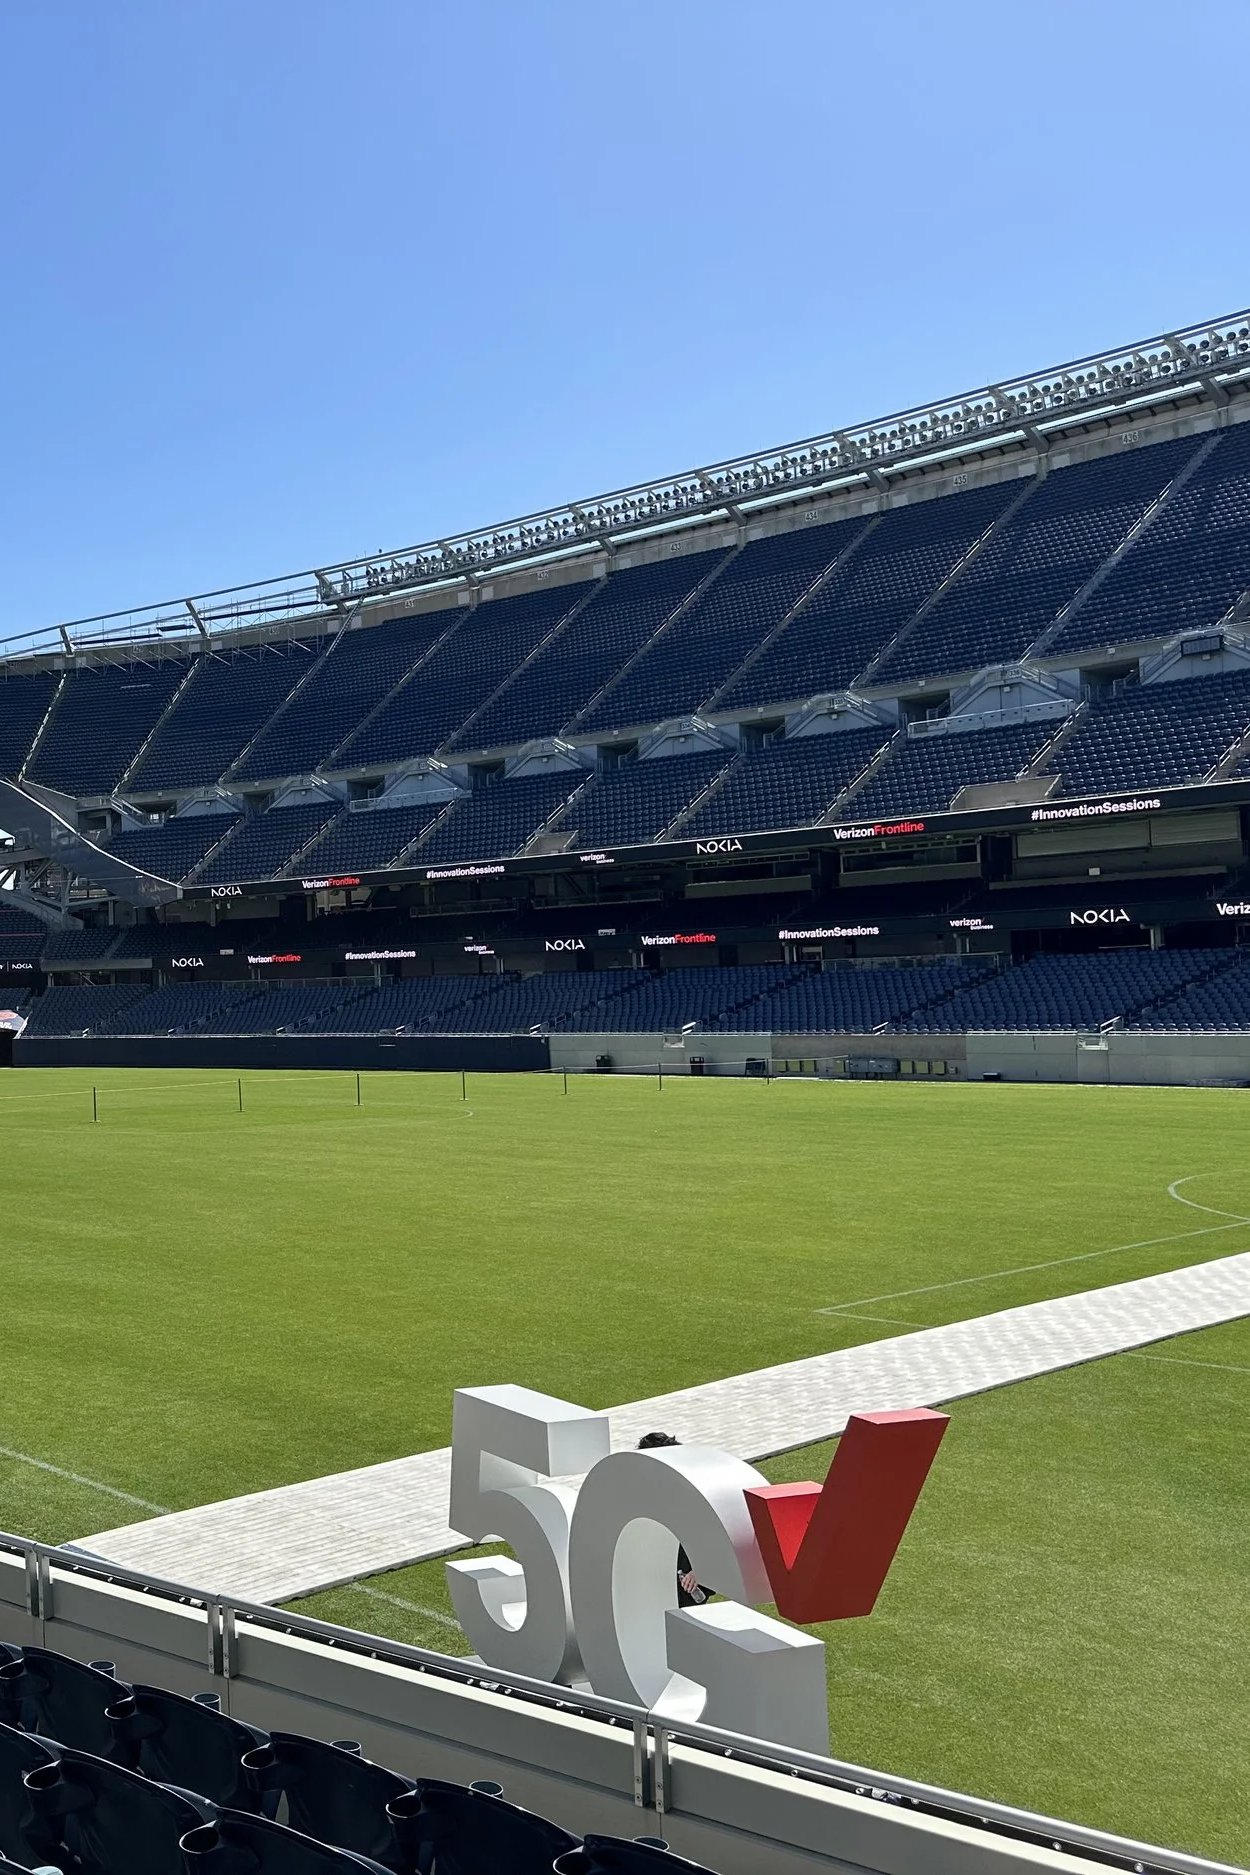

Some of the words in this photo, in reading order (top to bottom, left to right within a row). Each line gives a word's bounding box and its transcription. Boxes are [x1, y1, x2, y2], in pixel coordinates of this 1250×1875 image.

[1123, 432, 1138, 444] 436
[954, 475, 967, 486] 435
[805, 511, 818, 521] 434
[1031, 798, 1161, 821] #InnovationSessions
[833, 821, 925, 840] VerizonFrontline
[696, 839, 743, 855] NOKIA
[579, 853, 605, 861] verizon
[426, 864, 505, 879] #InnovationSessions
[302, 877, 360, 889] VerizonFrontline
[211, 886, 243, 897] NOKIA
[949, 918, 982, 927] verizon
[1071, 909, 1130, 925] NOKIA
[778, 925, 880, 940] #InnovationSessions
[545, 938, 586, 952] NOKIA
[641, 932, 716, 946] VerizonFrontline
[463, 944, 487, 952] verizon
[247, 954, 302, 964] VerizonFrontline
[345, 949, 417, 961] #InnovationSessions
[172, 957, 205, 968] NOKIA
[445, 1384, 831, 1756] 5G
